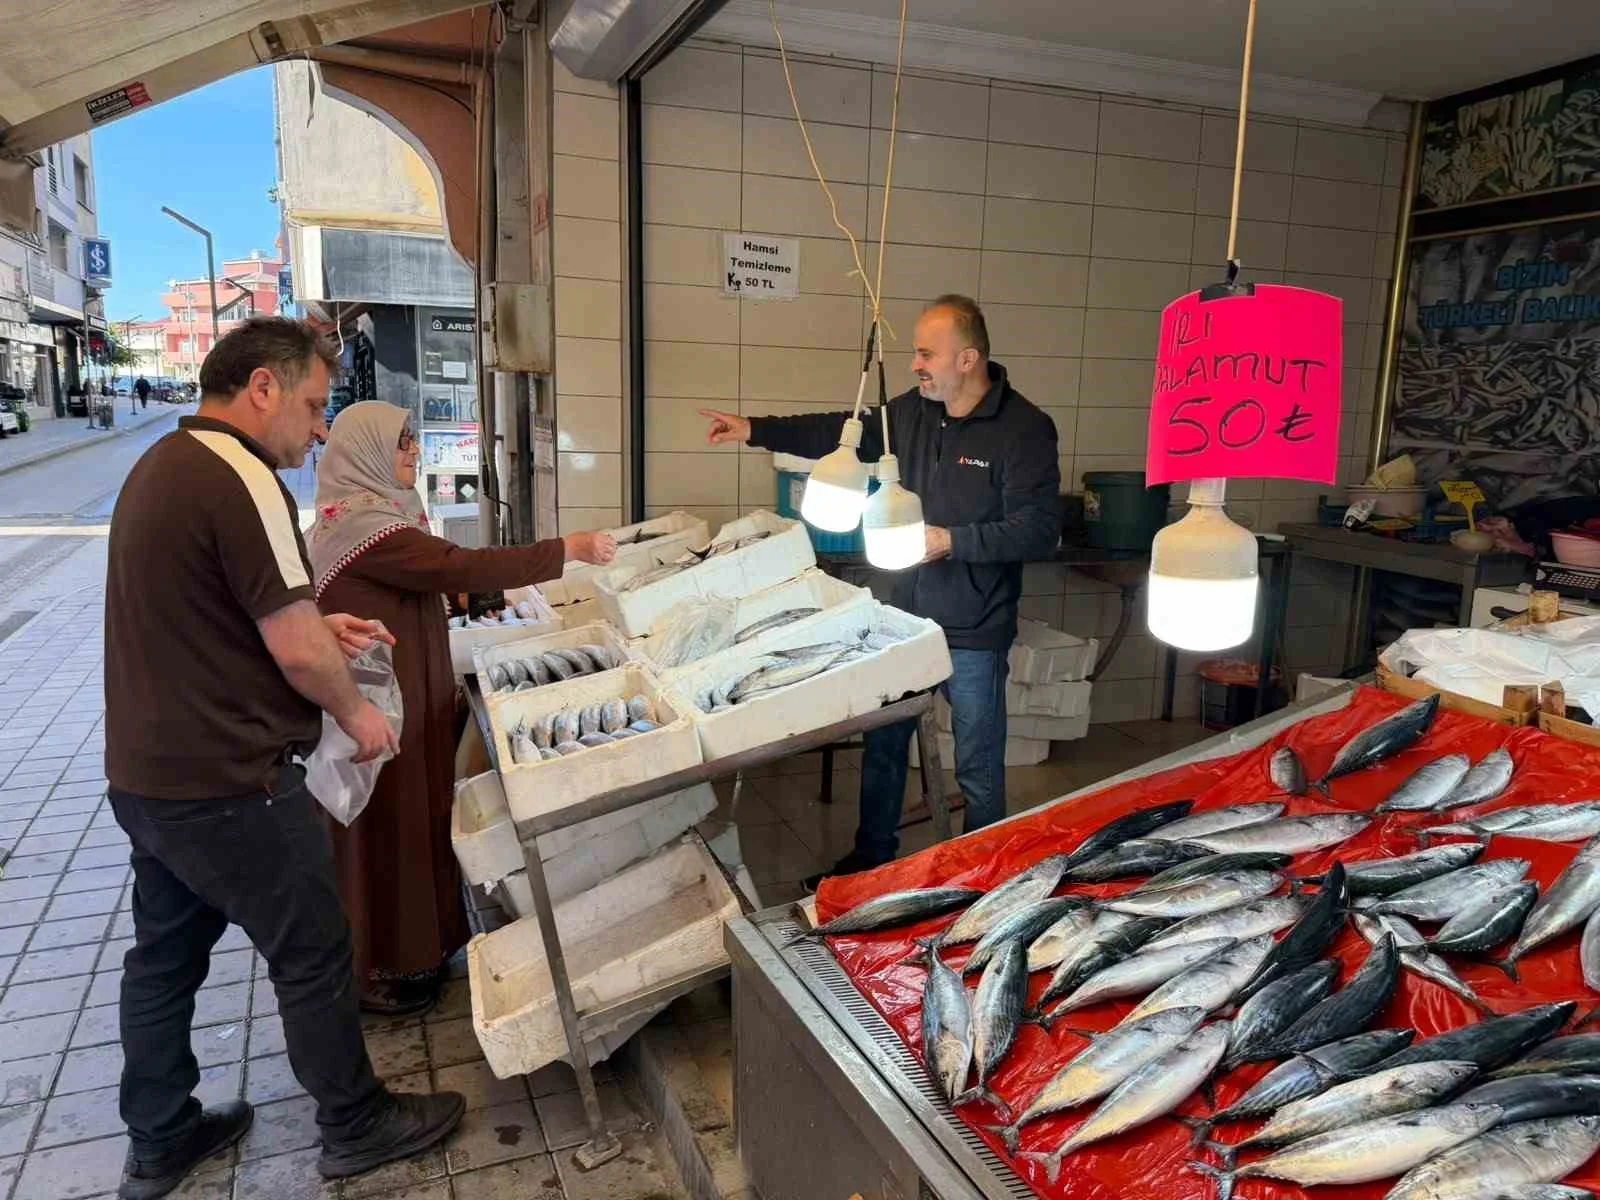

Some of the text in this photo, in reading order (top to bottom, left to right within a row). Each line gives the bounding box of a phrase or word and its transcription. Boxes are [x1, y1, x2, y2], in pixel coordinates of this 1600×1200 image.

[743, 241, 779, 255] Hamsi
[730, 256, 792, 274] Temizleme
[1495, 256, 1571, 291] BİZİM
[745, 278, 759, 288] 50
[761, 279, 776, 289] TL
[1418, 291, 1518, 330] TÜRKELİ
